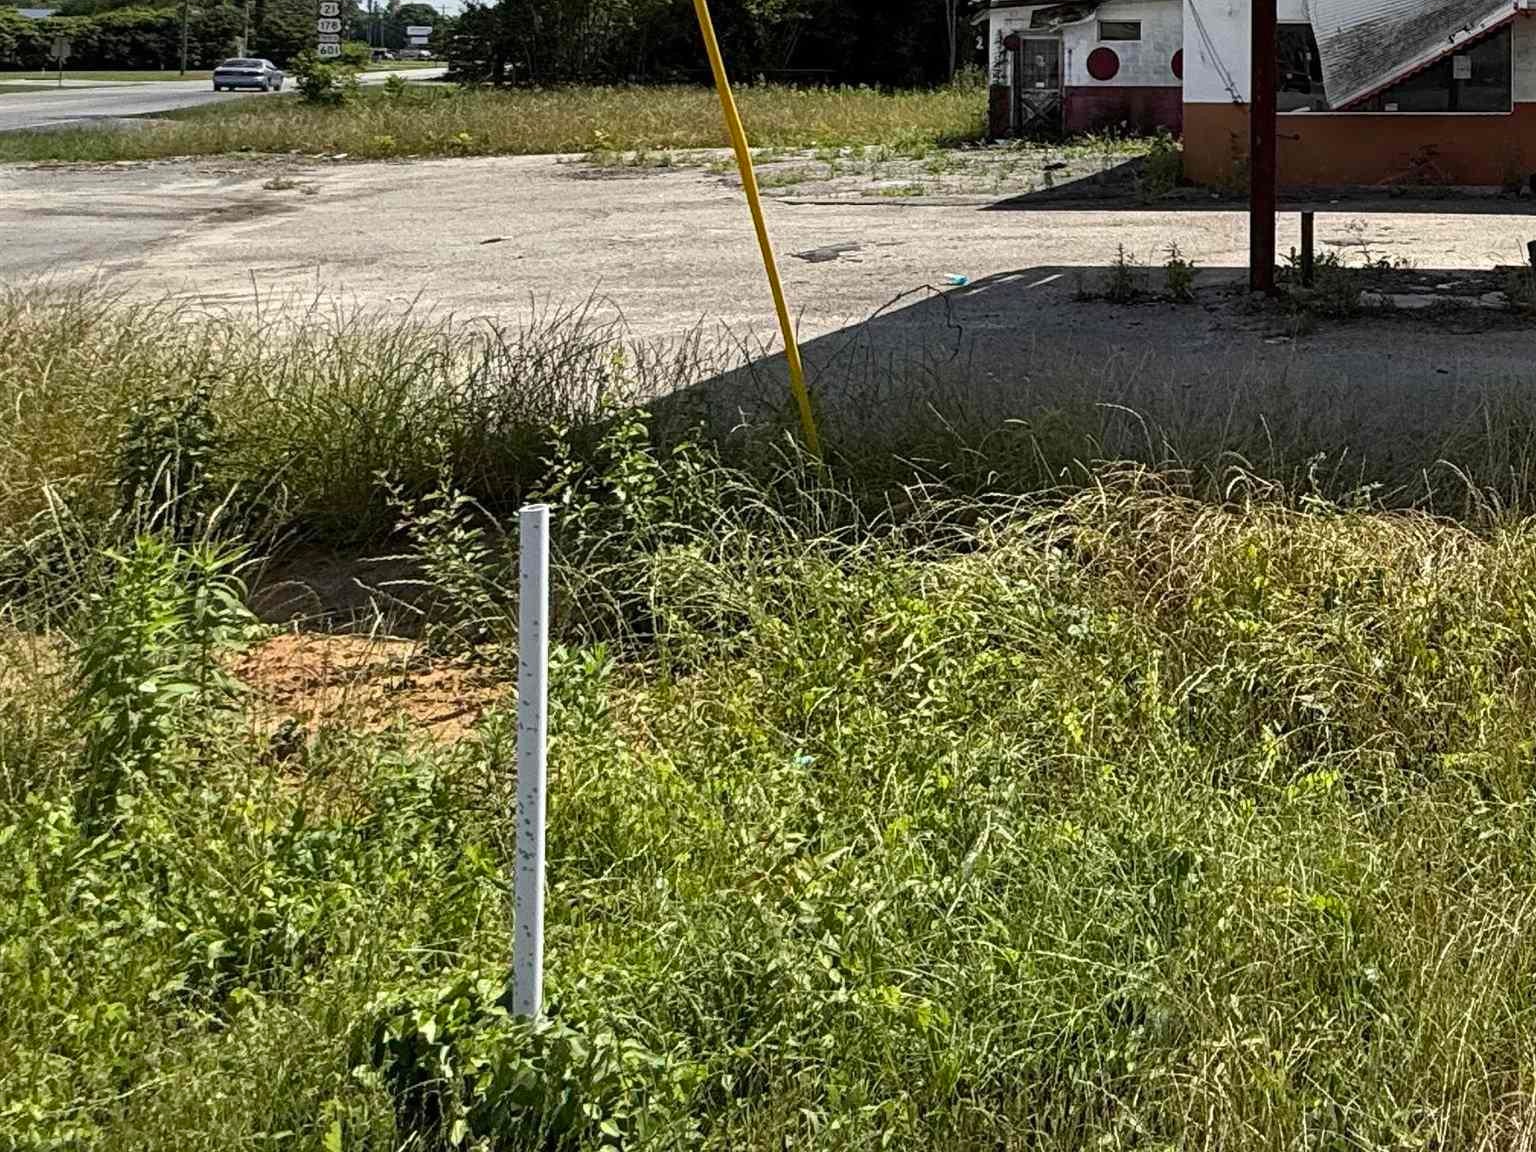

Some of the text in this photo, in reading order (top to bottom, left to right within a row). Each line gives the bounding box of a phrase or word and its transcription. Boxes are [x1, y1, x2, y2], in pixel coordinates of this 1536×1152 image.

[324, 4, 336, 14] 21
[321, 21, 338, 30] 178
[320, 46, 338, 55] 601
